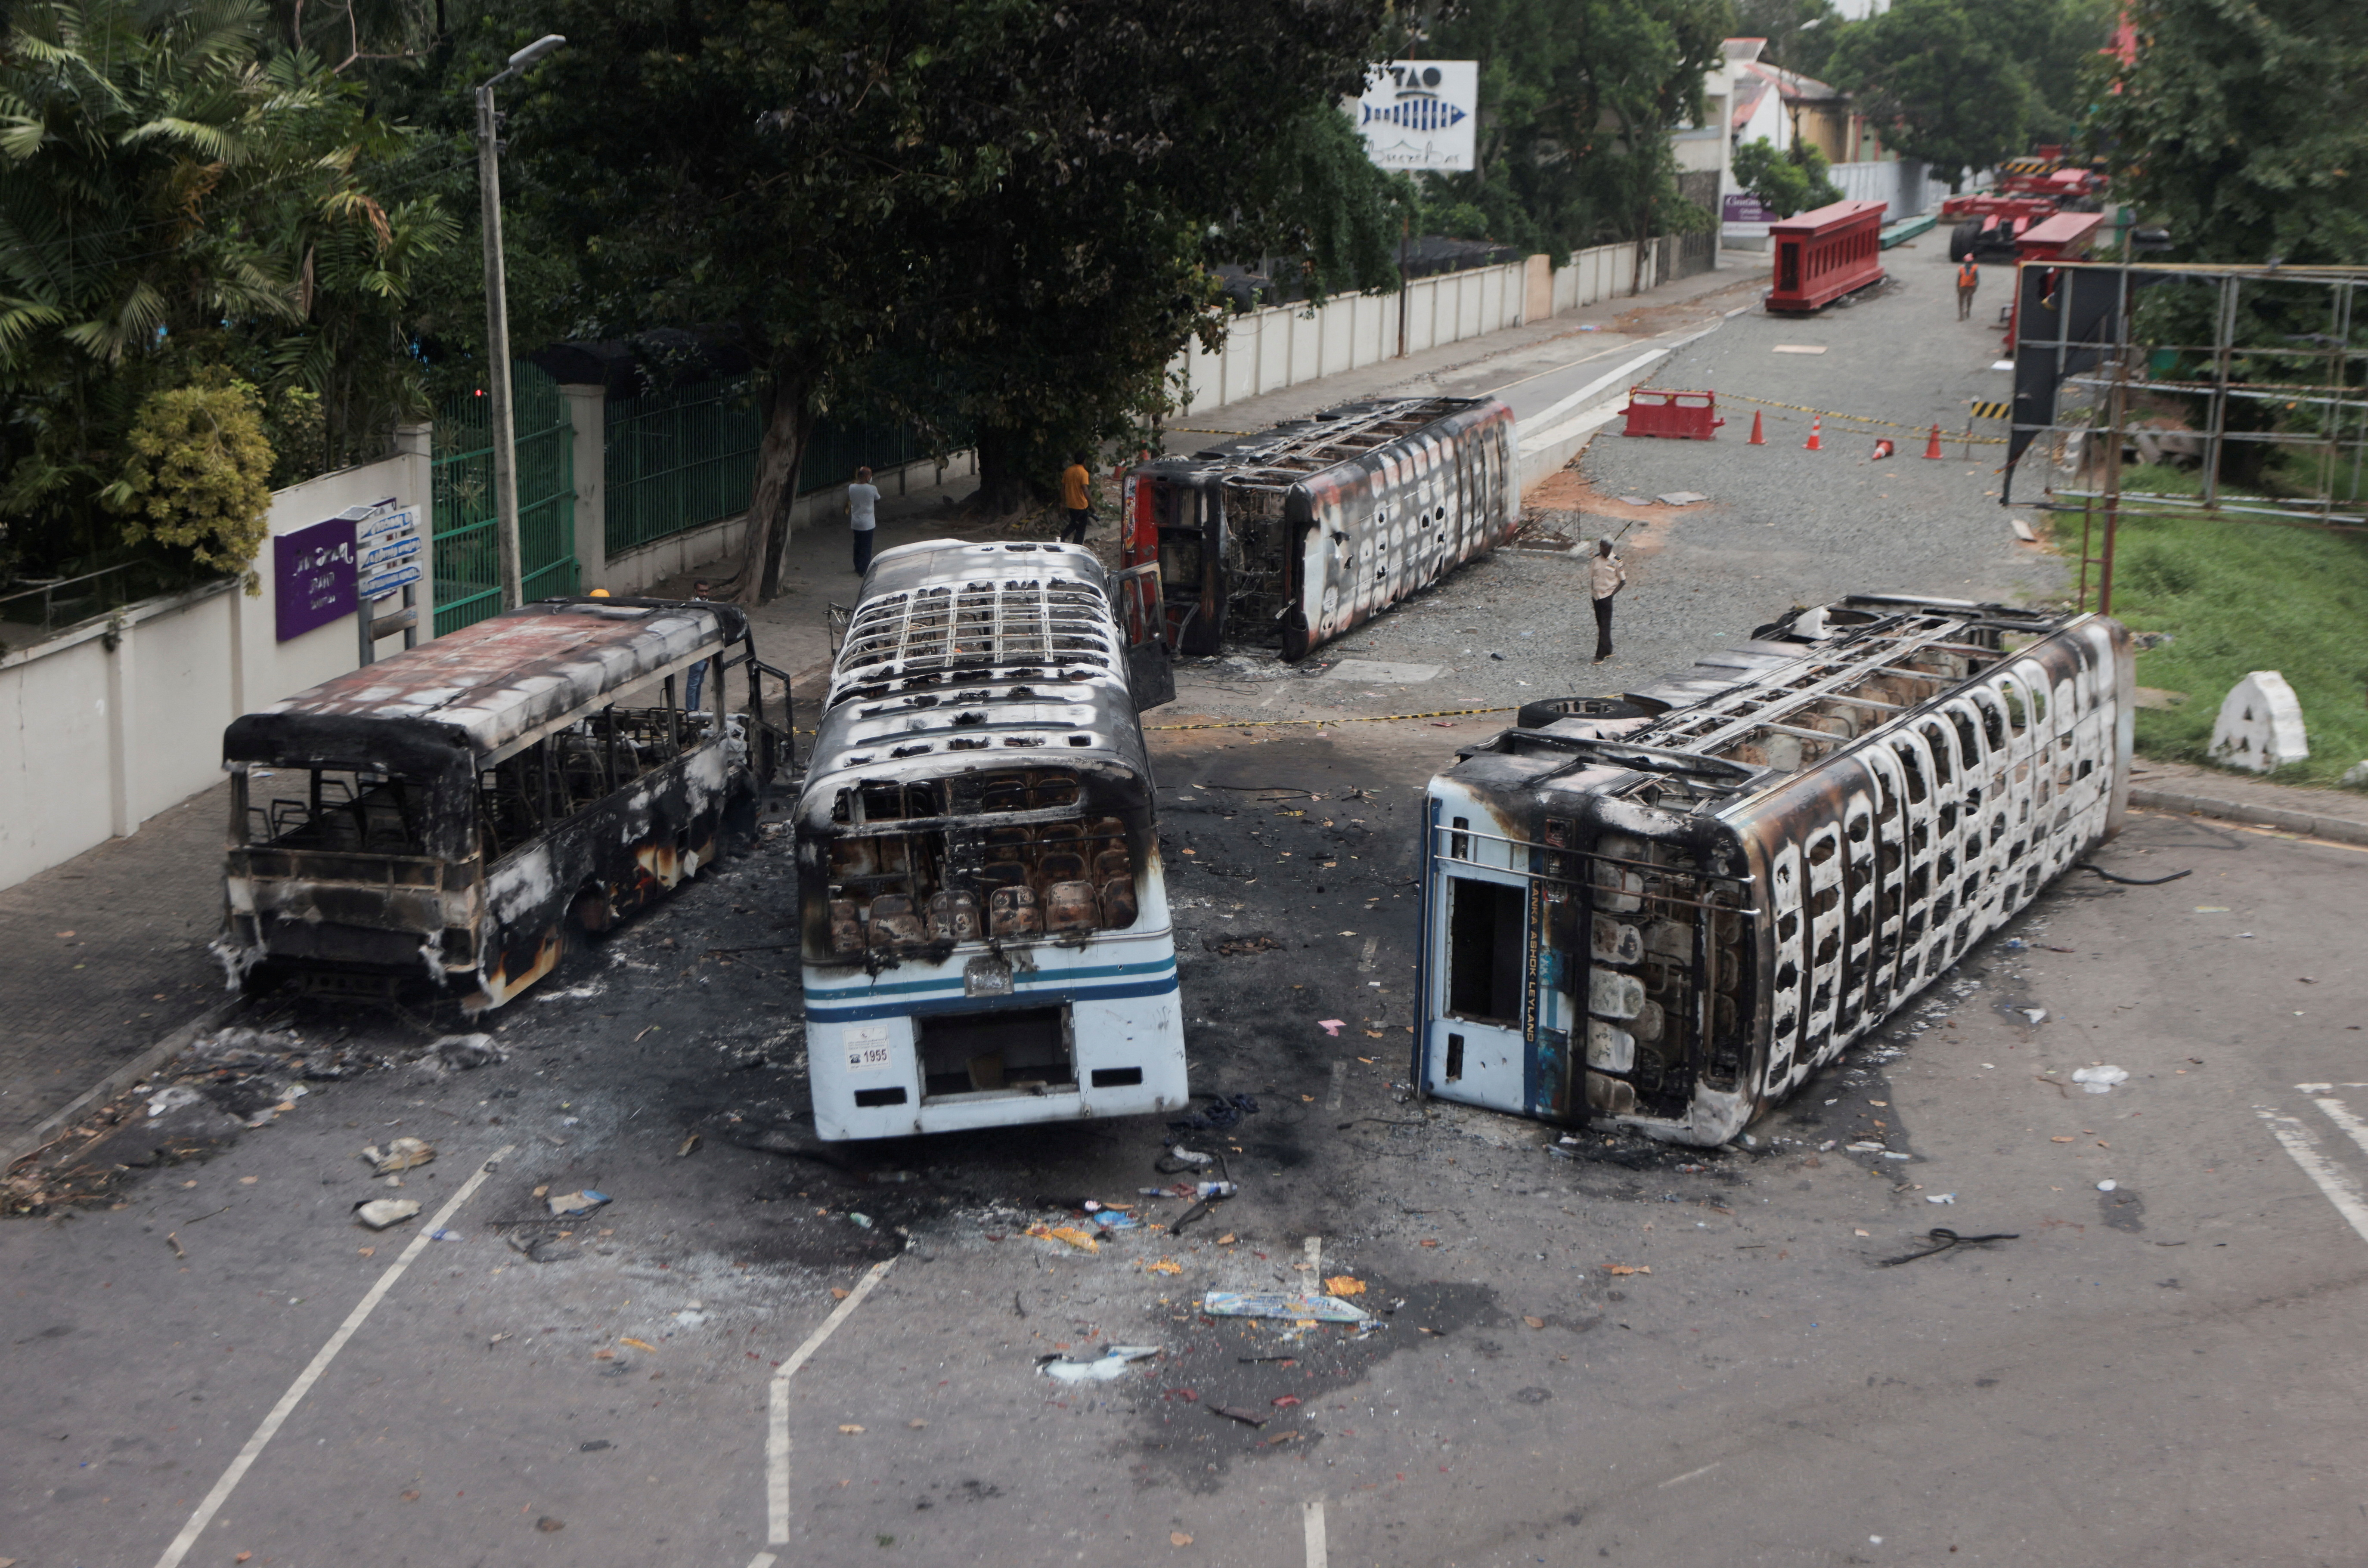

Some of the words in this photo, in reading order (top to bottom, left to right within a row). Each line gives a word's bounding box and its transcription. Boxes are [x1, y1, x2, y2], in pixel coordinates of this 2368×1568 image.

[1392, 67, 1441, 87] TAO
[1531, 880, 1539, 925] LANKA
[1529, 931, 1537, 977] ASHOK
[1527, 982, 1536, 1042] LEYLAND
[864, 1048, 887, 1062] 1955
